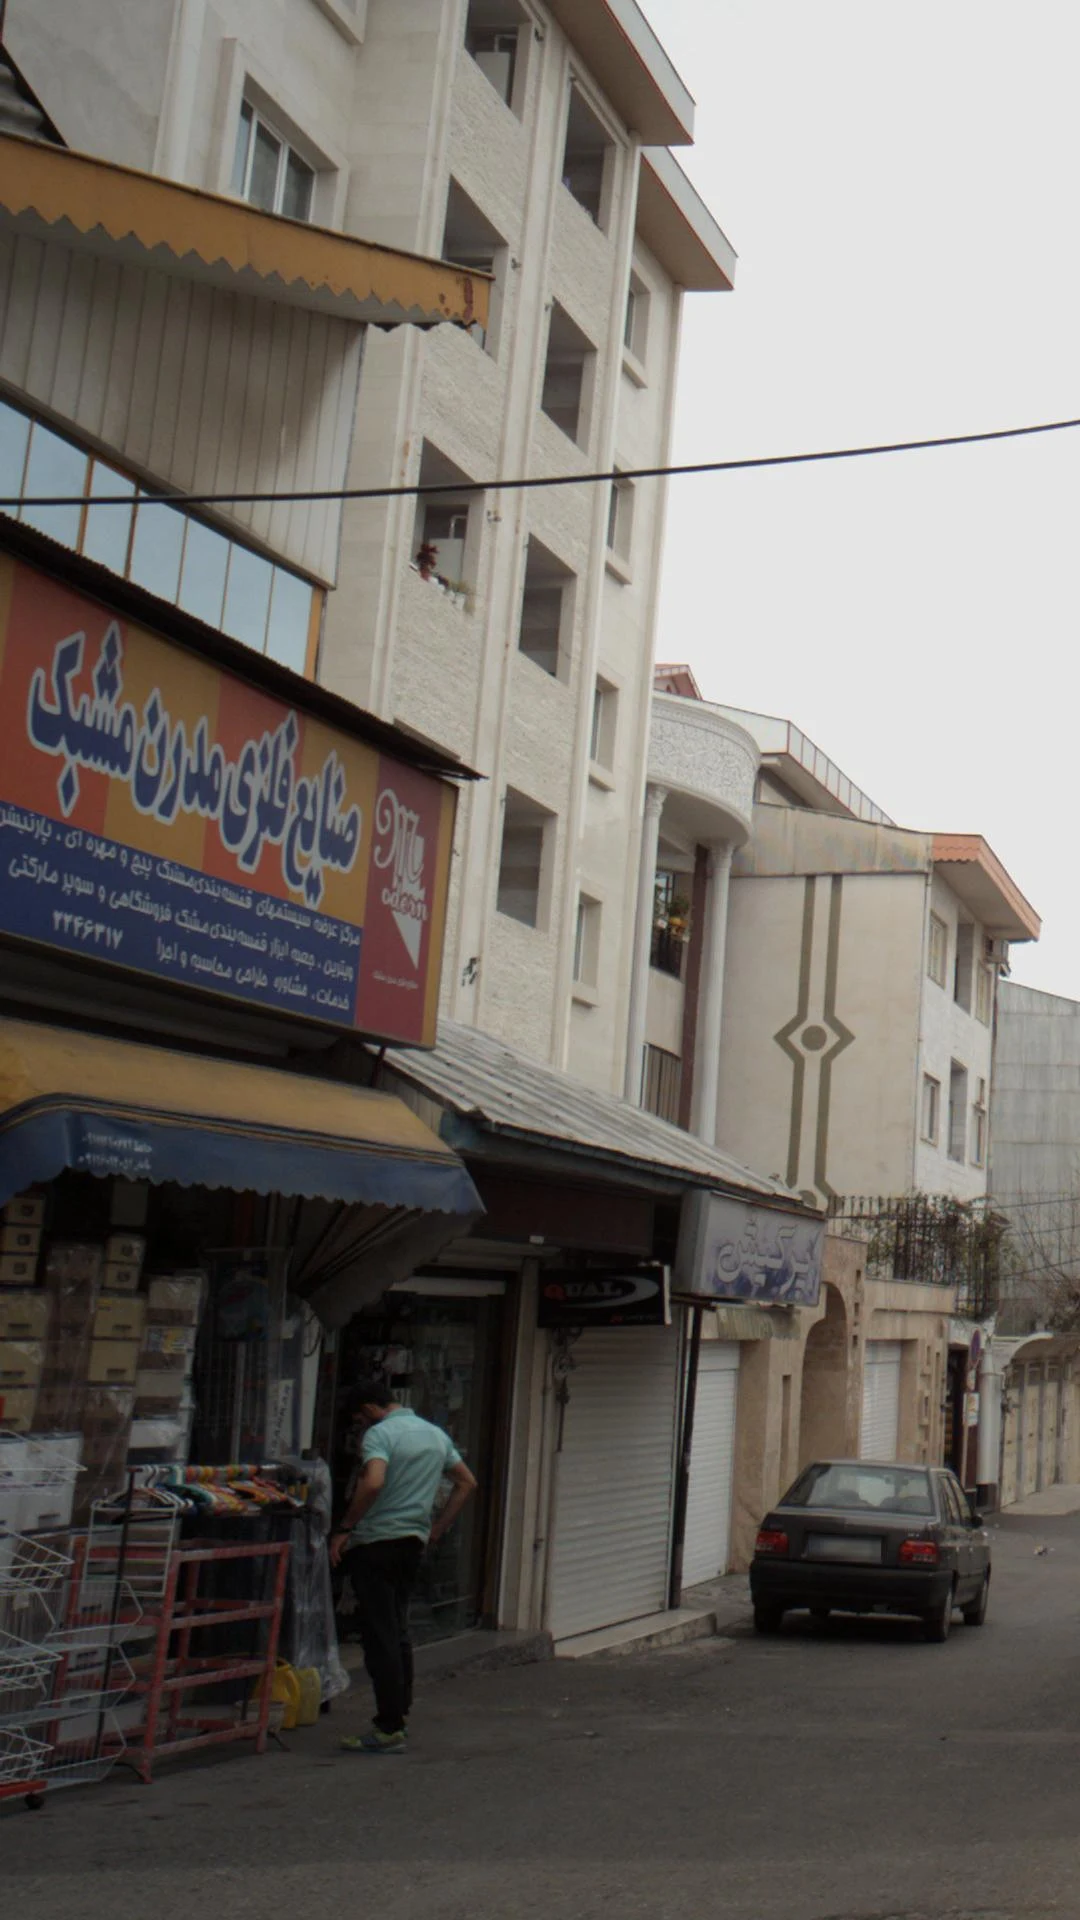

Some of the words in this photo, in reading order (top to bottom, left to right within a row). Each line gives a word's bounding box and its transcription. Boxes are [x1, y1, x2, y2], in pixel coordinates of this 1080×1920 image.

[27, 619, 137, 818] مشبک
[131, 687, 225, 826] مدرن
[219, 709, 299, 874] فلزی
[120, 848, 128, 868] و
[282, 751, 362, 910] صنایع
